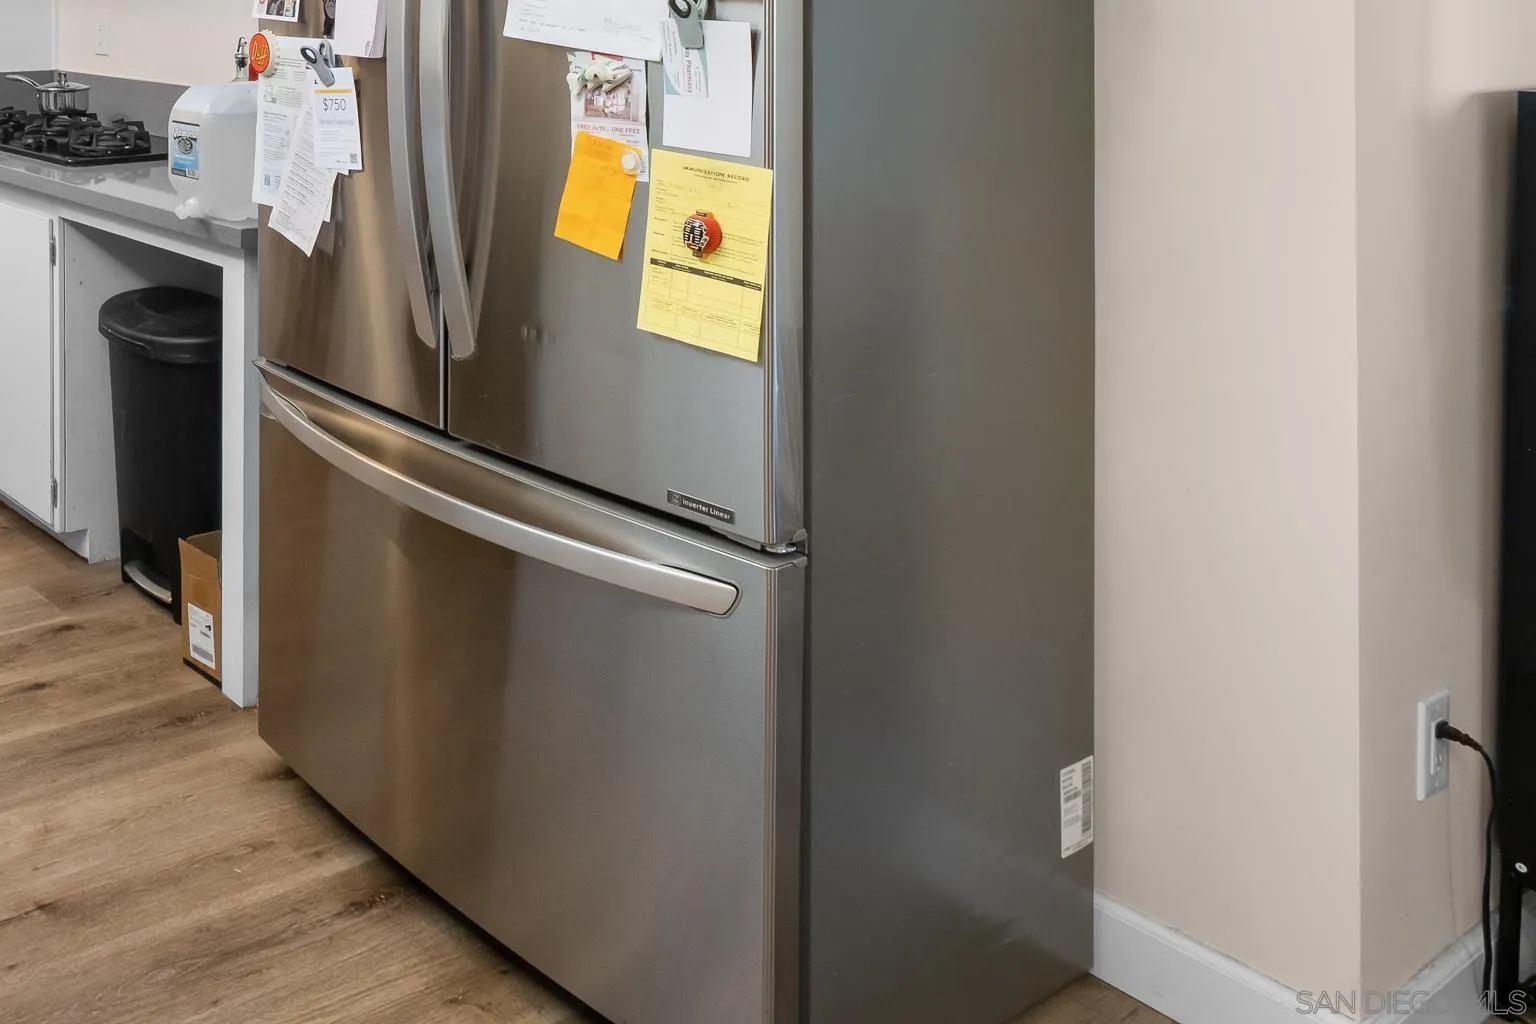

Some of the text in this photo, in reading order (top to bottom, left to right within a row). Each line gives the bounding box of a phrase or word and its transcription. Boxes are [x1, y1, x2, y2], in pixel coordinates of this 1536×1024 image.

[322, 98, 347, 112] $750
[681, 165, 750, 182] IMMUNIZATION RECORD
[683, 498, 730, 520] Inverter Linear
